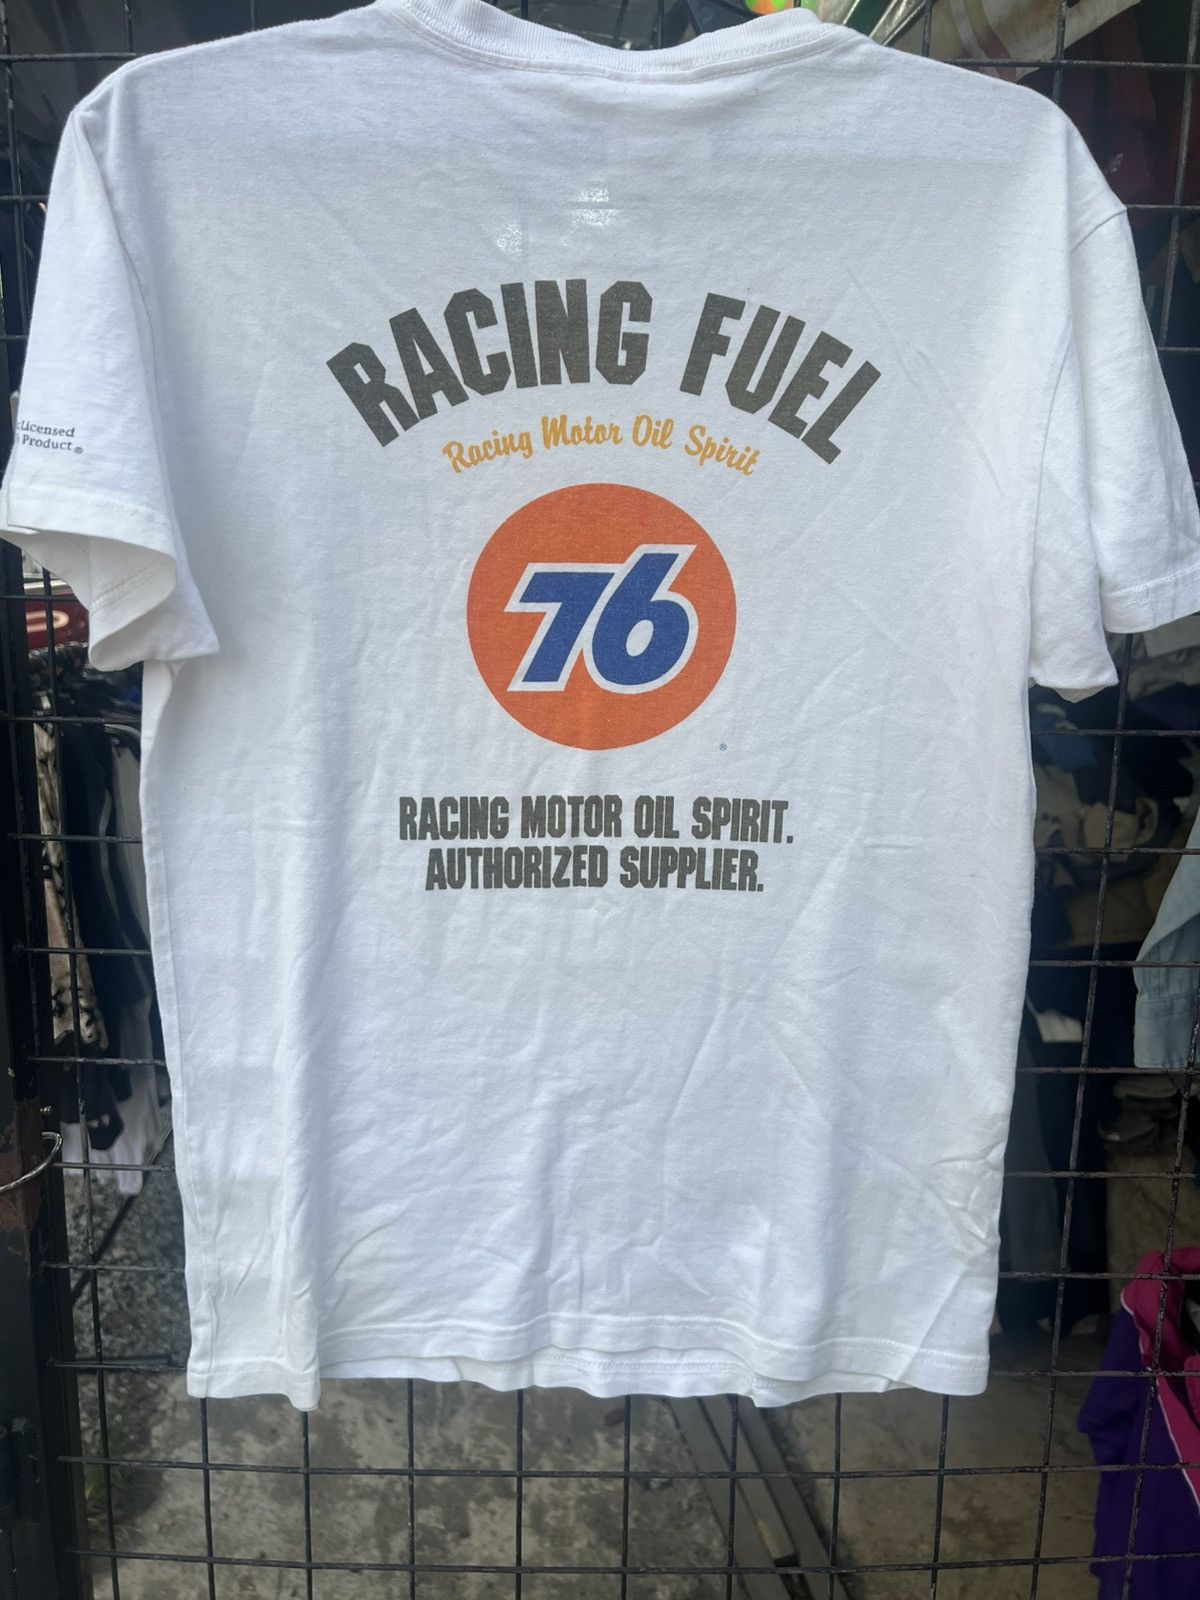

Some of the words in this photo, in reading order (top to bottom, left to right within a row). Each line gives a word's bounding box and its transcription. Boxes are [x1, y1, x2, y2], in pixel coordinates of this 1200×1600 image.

[327, 279, 653, 446] RACING
[680, 293, 880, 464] FUEL
[21, 420, 76, 437] Licensed
[443, 428, 533, 474] Racing
[541, 413, 621, 448] Motor
[631, 413, 674, 449] Oil
[684, 425, 760, 476] Spirit
[505, 543, 698, 695] 76
[400, 796, 509, 841] RACING
[521, 795, 622, 838] MOTOR
[634, 795, 680, 839] OIL
[692, 797, 794, 844] SPIRIT.
[425, 845, 608, 891] AUTHORIZED
[620, 847, 764, 892] SUPPLIER.
